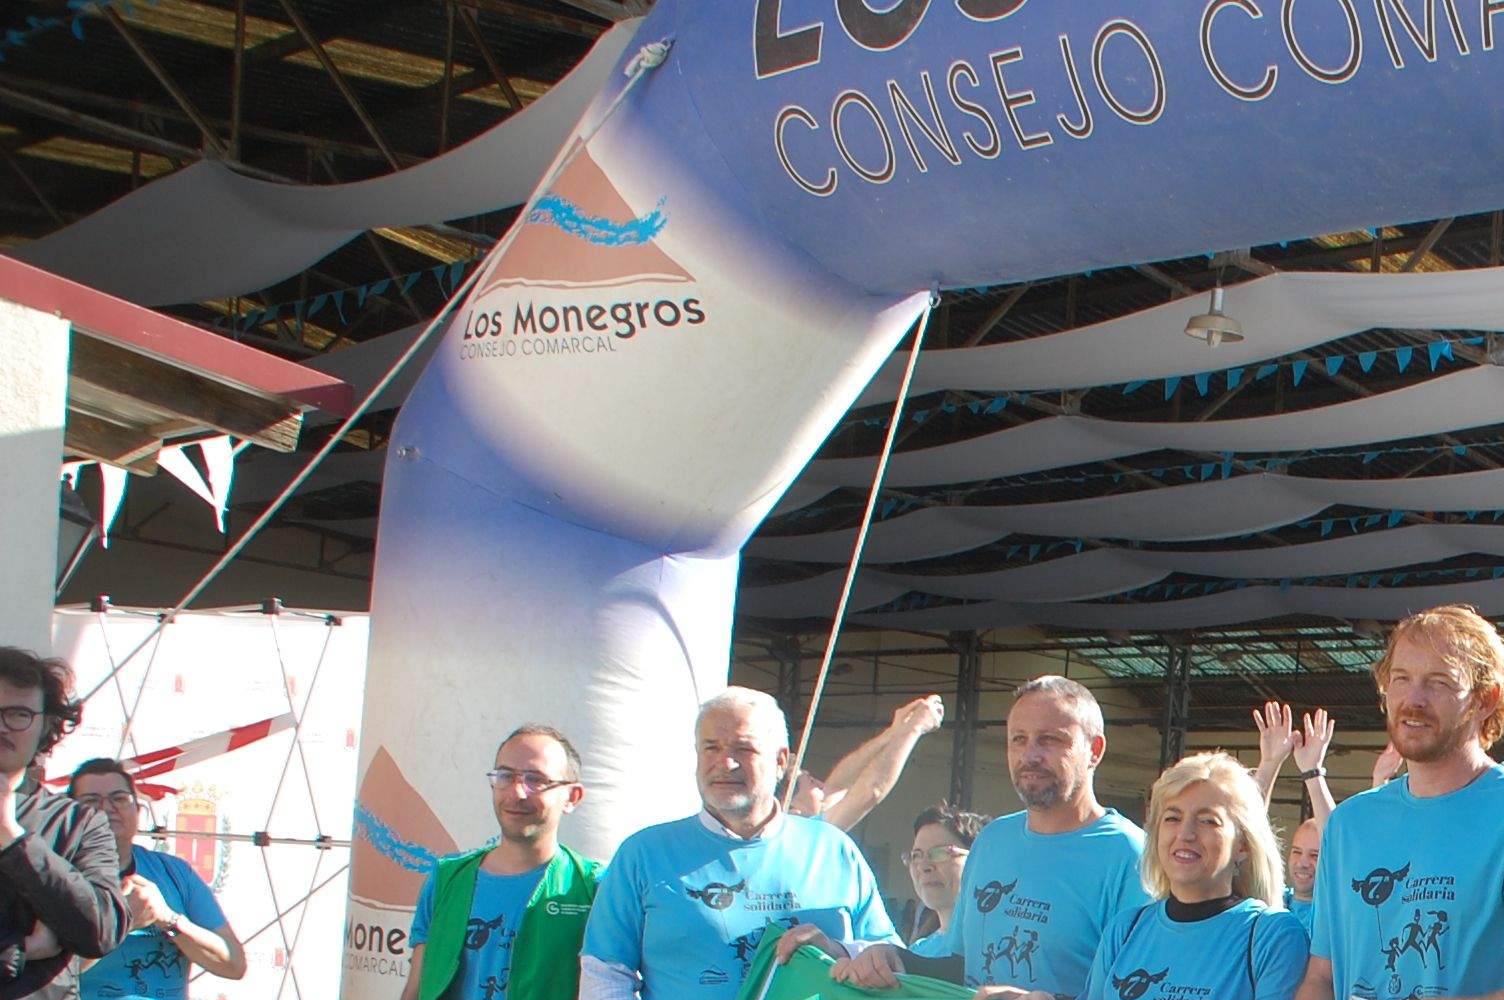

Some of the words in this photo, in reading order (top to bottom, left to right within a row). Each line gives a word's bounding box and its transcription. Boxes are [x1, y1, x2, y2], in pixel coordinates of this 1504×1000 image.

[774, 17, 1166, 196] CONSEJO
[463, 308, 503, 341] Los
[513, 297, 706, 339] Monegros
[459, 339, 517, 361] CONSEJO
[522, 335, 617, 357] COMARCAL
[1405, 875, 1455, 890] Carrera
[1008, 895, 1052, 912] Carrera
[1402, 887, 1456, 904] solidaria
[1004, 907, 1049, 924] solidaria
[1160, 982, 1212, 996] Carrera
